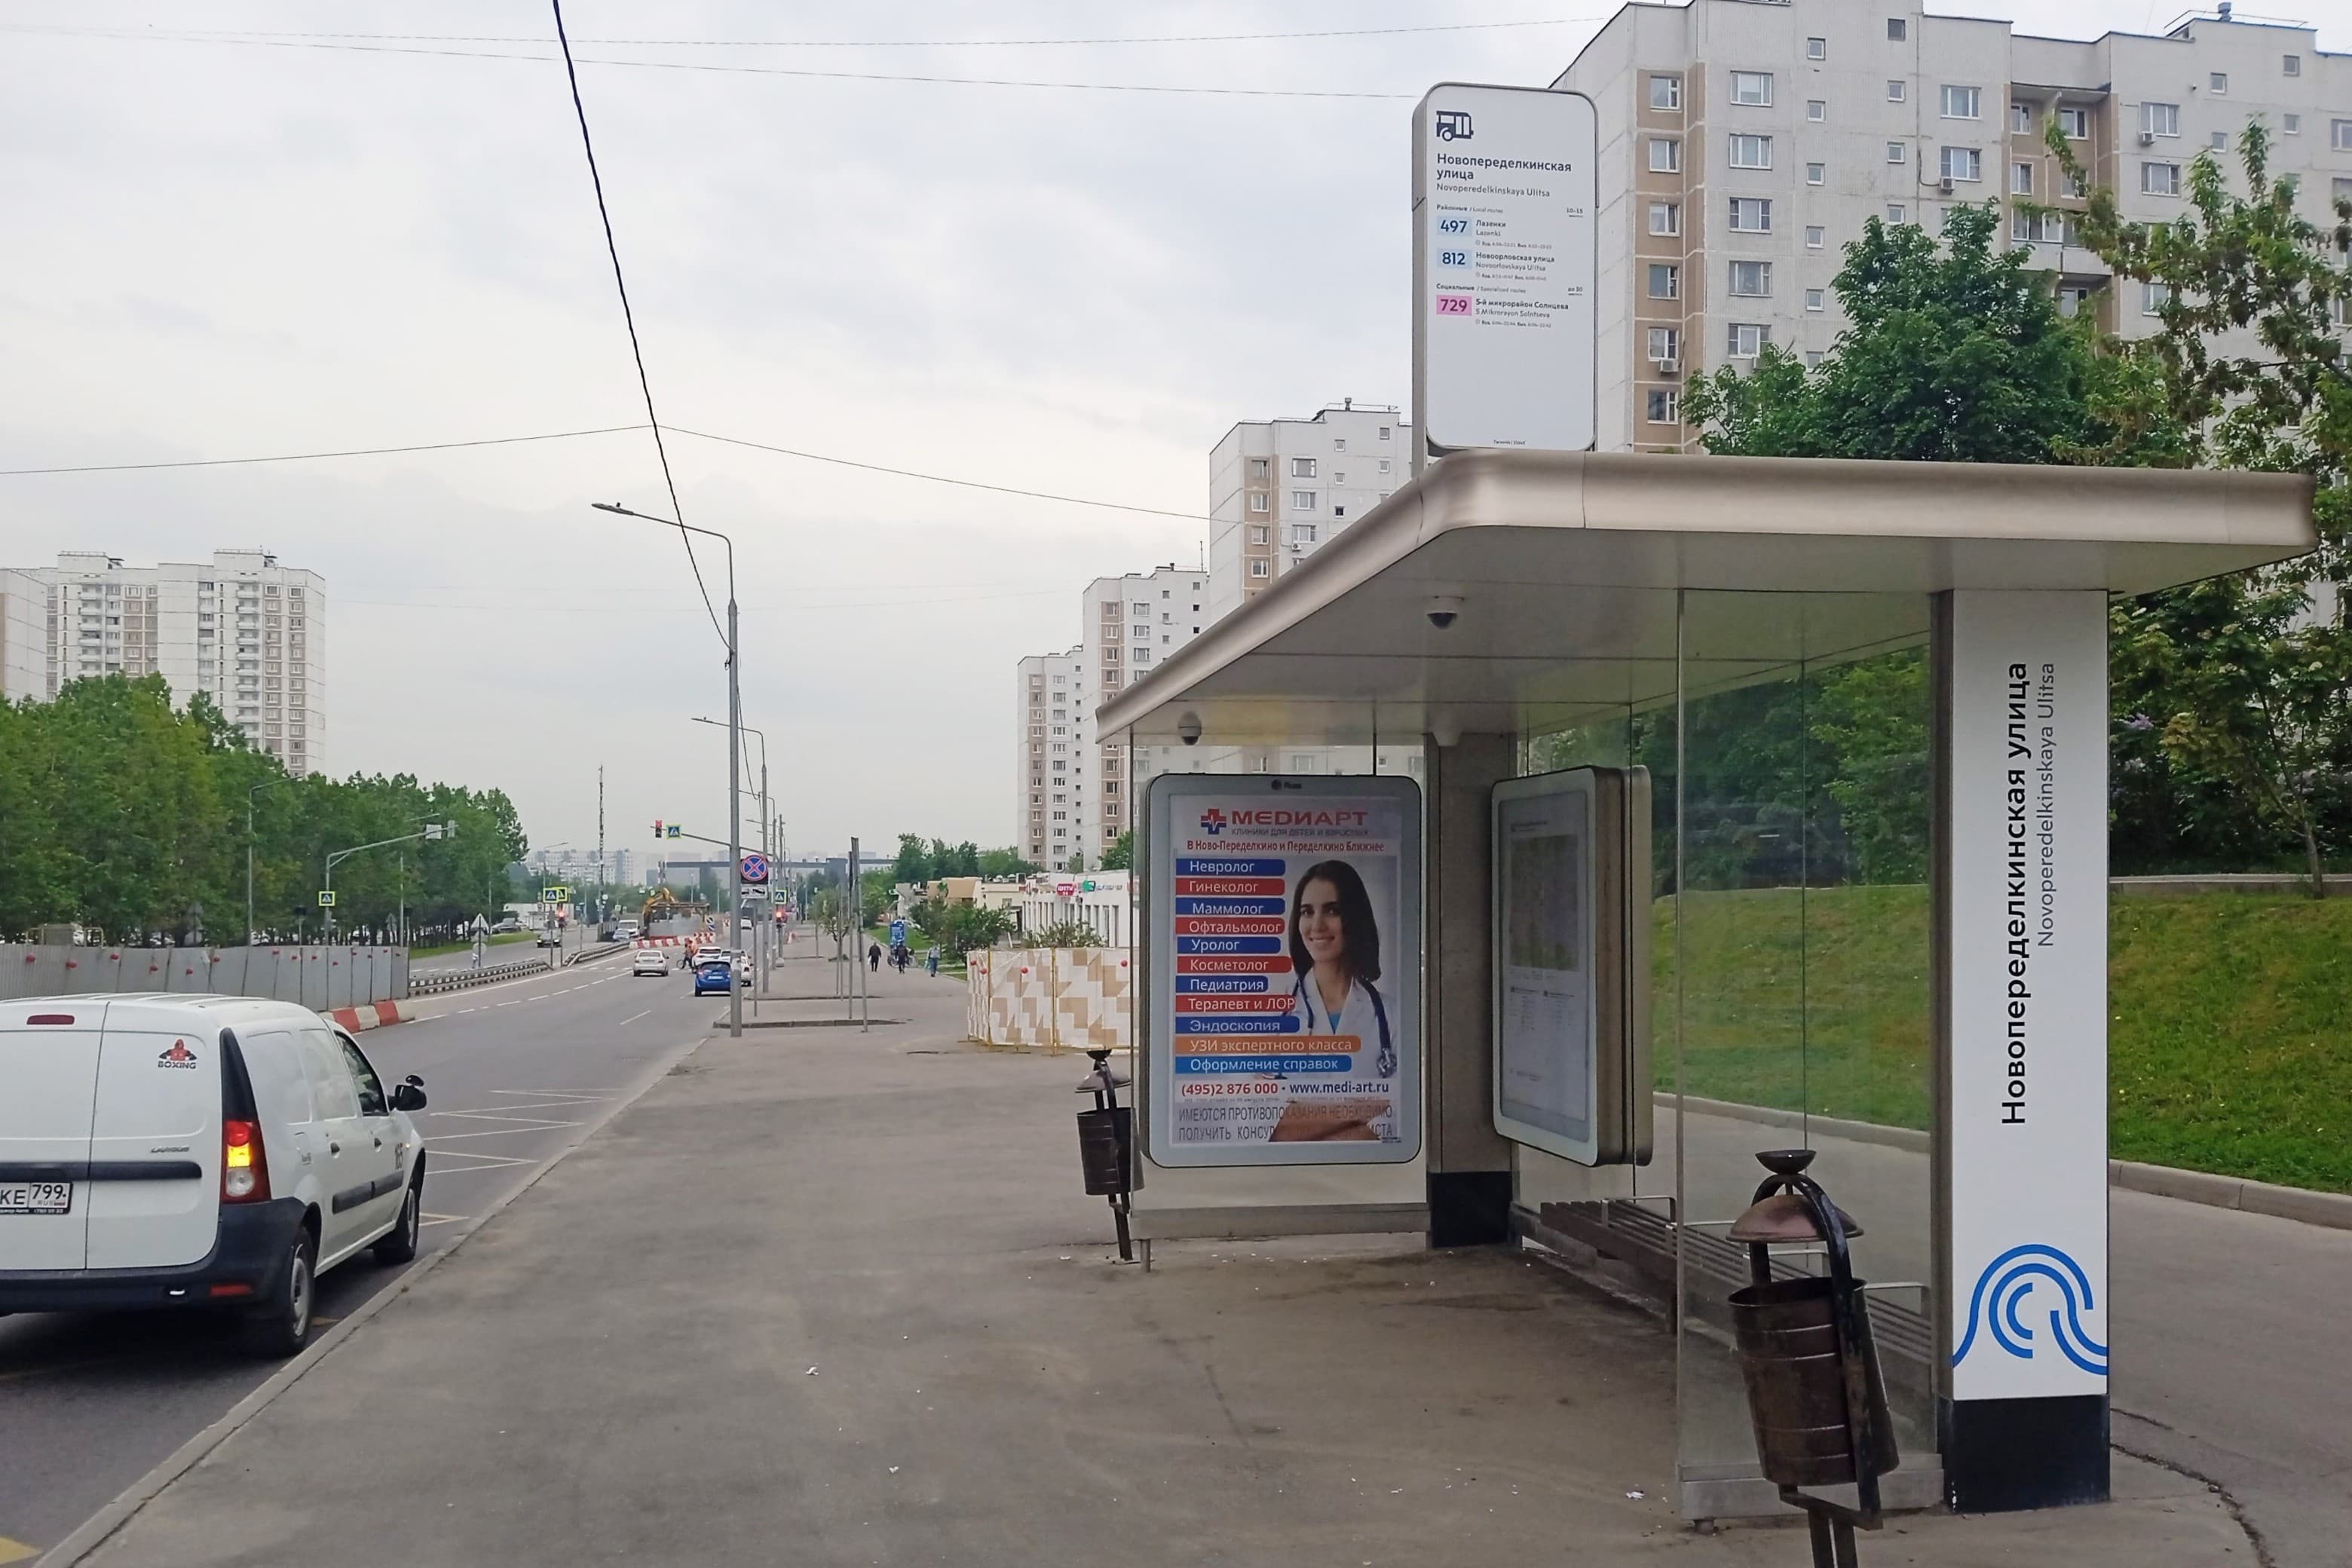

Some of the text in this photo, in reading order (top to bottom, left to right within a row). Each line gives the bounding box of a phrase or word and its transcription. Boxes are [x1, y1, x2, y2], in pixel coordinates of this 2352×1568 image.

[1437, 153, 1572, 172] Новопеределкинская
[1437, 169, 1474, 181] улица
[1436, 183, 1550, 198] Novoperedelkinskaya Ulitsa
[1440, 219, 1506, 233] 497 Лазенки
[1442, 253, 1465, 265] 812
[1476, 253, 1532, 261] Новоорловская
[1476, 262, 1526, 271] Novoorlovskaya
[1441, 299, 1468, 311] 729
[1534, 302, 1569, 310] Солнцева
[2037, 663, 2056, 947] Novoperedelkinskaya Ulitsa
[1187, 841, 1193, 850] В
[1196, 841, 1279, 853] Ново-Переделкино
[1288, 841, 1344, 853] Переделкино
[1346, 841, 1385, 852] Ближнее
[1190, 861, 1255, 875] Невролог
[1189, 881, 1259, 894] Гинеколог
[2002, 663, 2032, 1123] Новопеределкинская улица
[1193, 904, 1263, 917] Маммолог
[1189, 921, 1282, 936] Офтальмолог
[1191, 939, 1240, 953] Уролог
[1190, 960, 1269, 972] Косметолог
[1190, 980, 1264, 992] Педиатрия
[1188, 999, 1251, 1012] Терапевт
[1266, 998, 1295, 1009] ЛОР
[1190, 1021, 1280, 1034] Эндоскопия
[1190, 1040, 1352, 1052] УЗИ экспертного класса
[158, 1061, 197, 1069] BOXING
[1190, 1059, 1338, 1073] Оформление справок
[1181, 1081, 1389, 1096] (495)2 876 000 www.medi-art.ru
[1179, 1108, 1226, 1122] ИМЕЮТСЯ
[1178, 1127, 1231, 1141] ПОЛУЧИТЬ
[32, 1184, 63, 1199] 799
